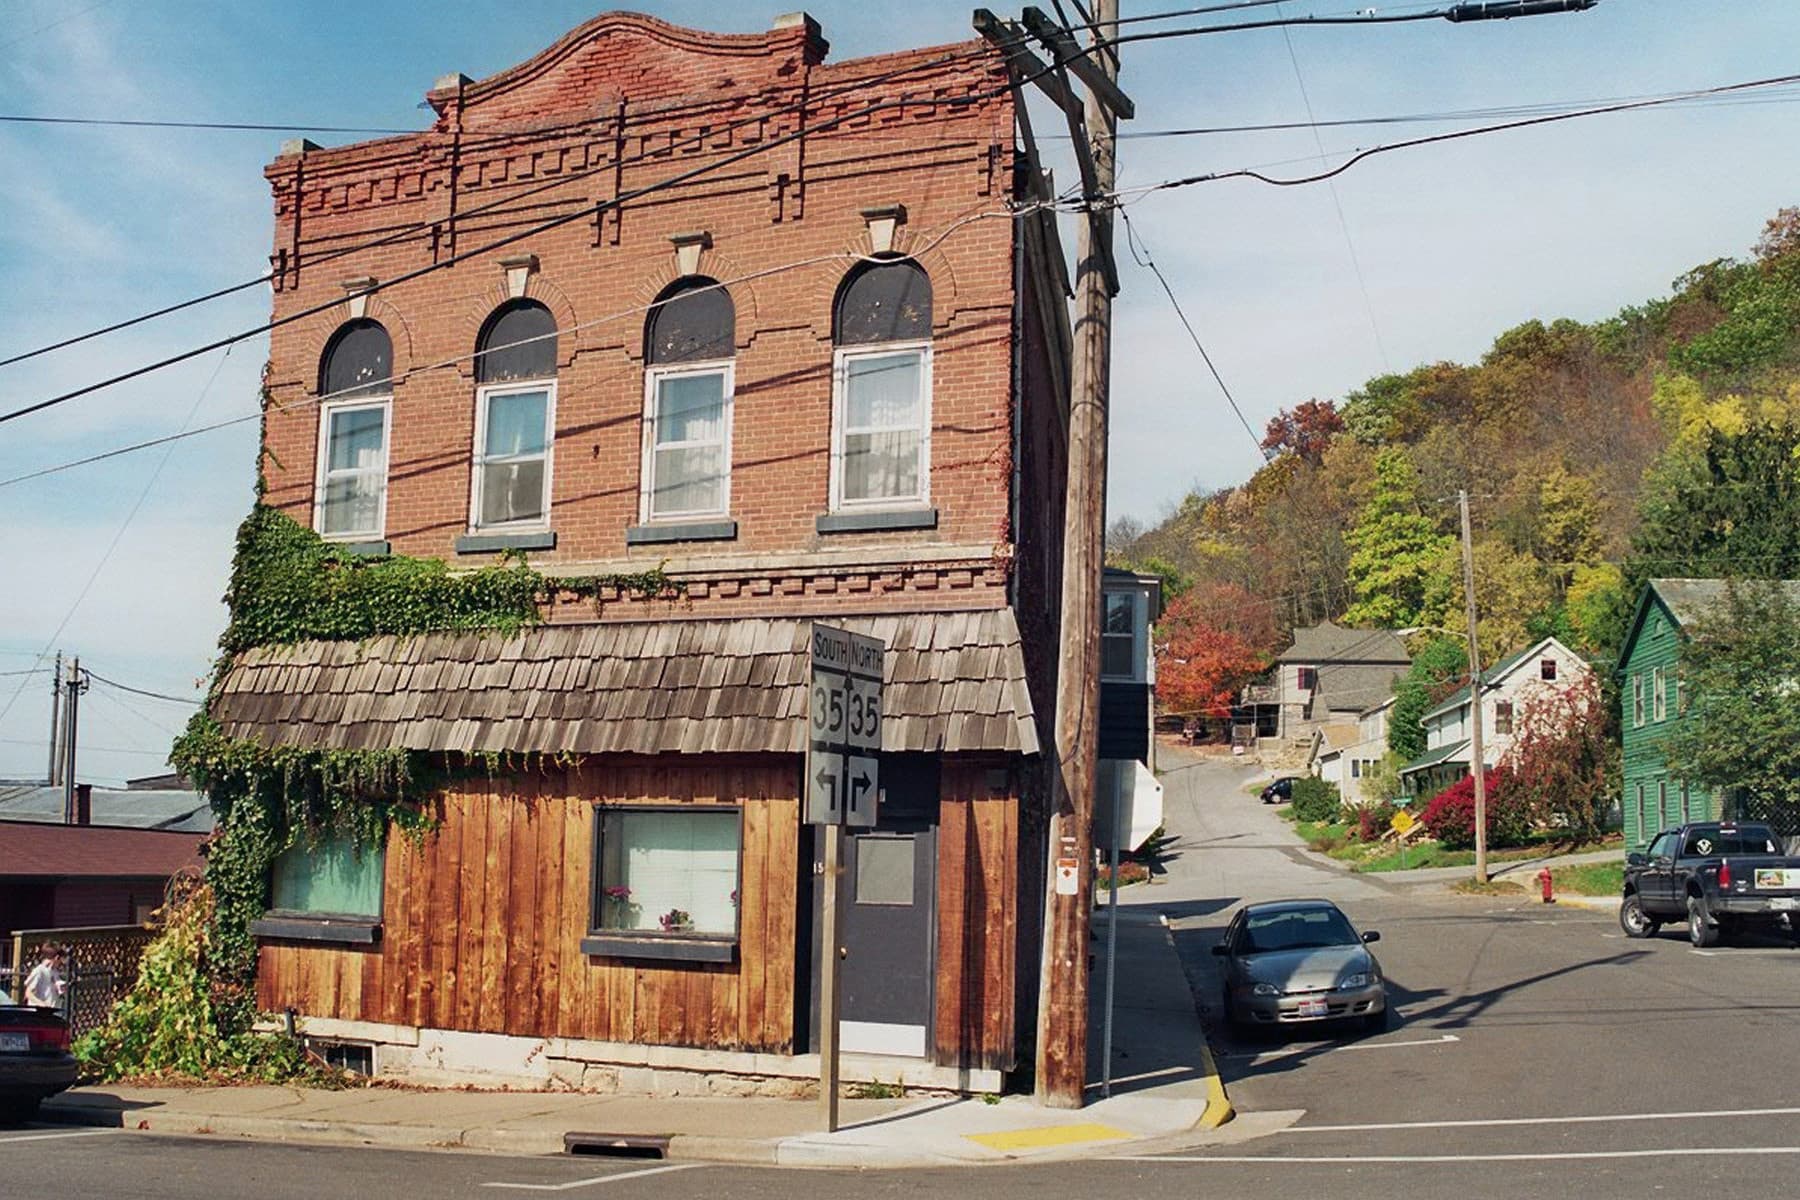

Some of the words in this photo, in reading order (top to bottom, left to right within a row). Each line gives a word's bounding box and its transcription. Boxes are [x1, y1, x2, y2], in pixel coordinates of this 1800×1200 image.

[814, 631, 848, 665] SOUTH
[851, 641, 884, 671] NORTH
[813, 686, 843, 732] 35
[851, 693, 878, 738] 35
